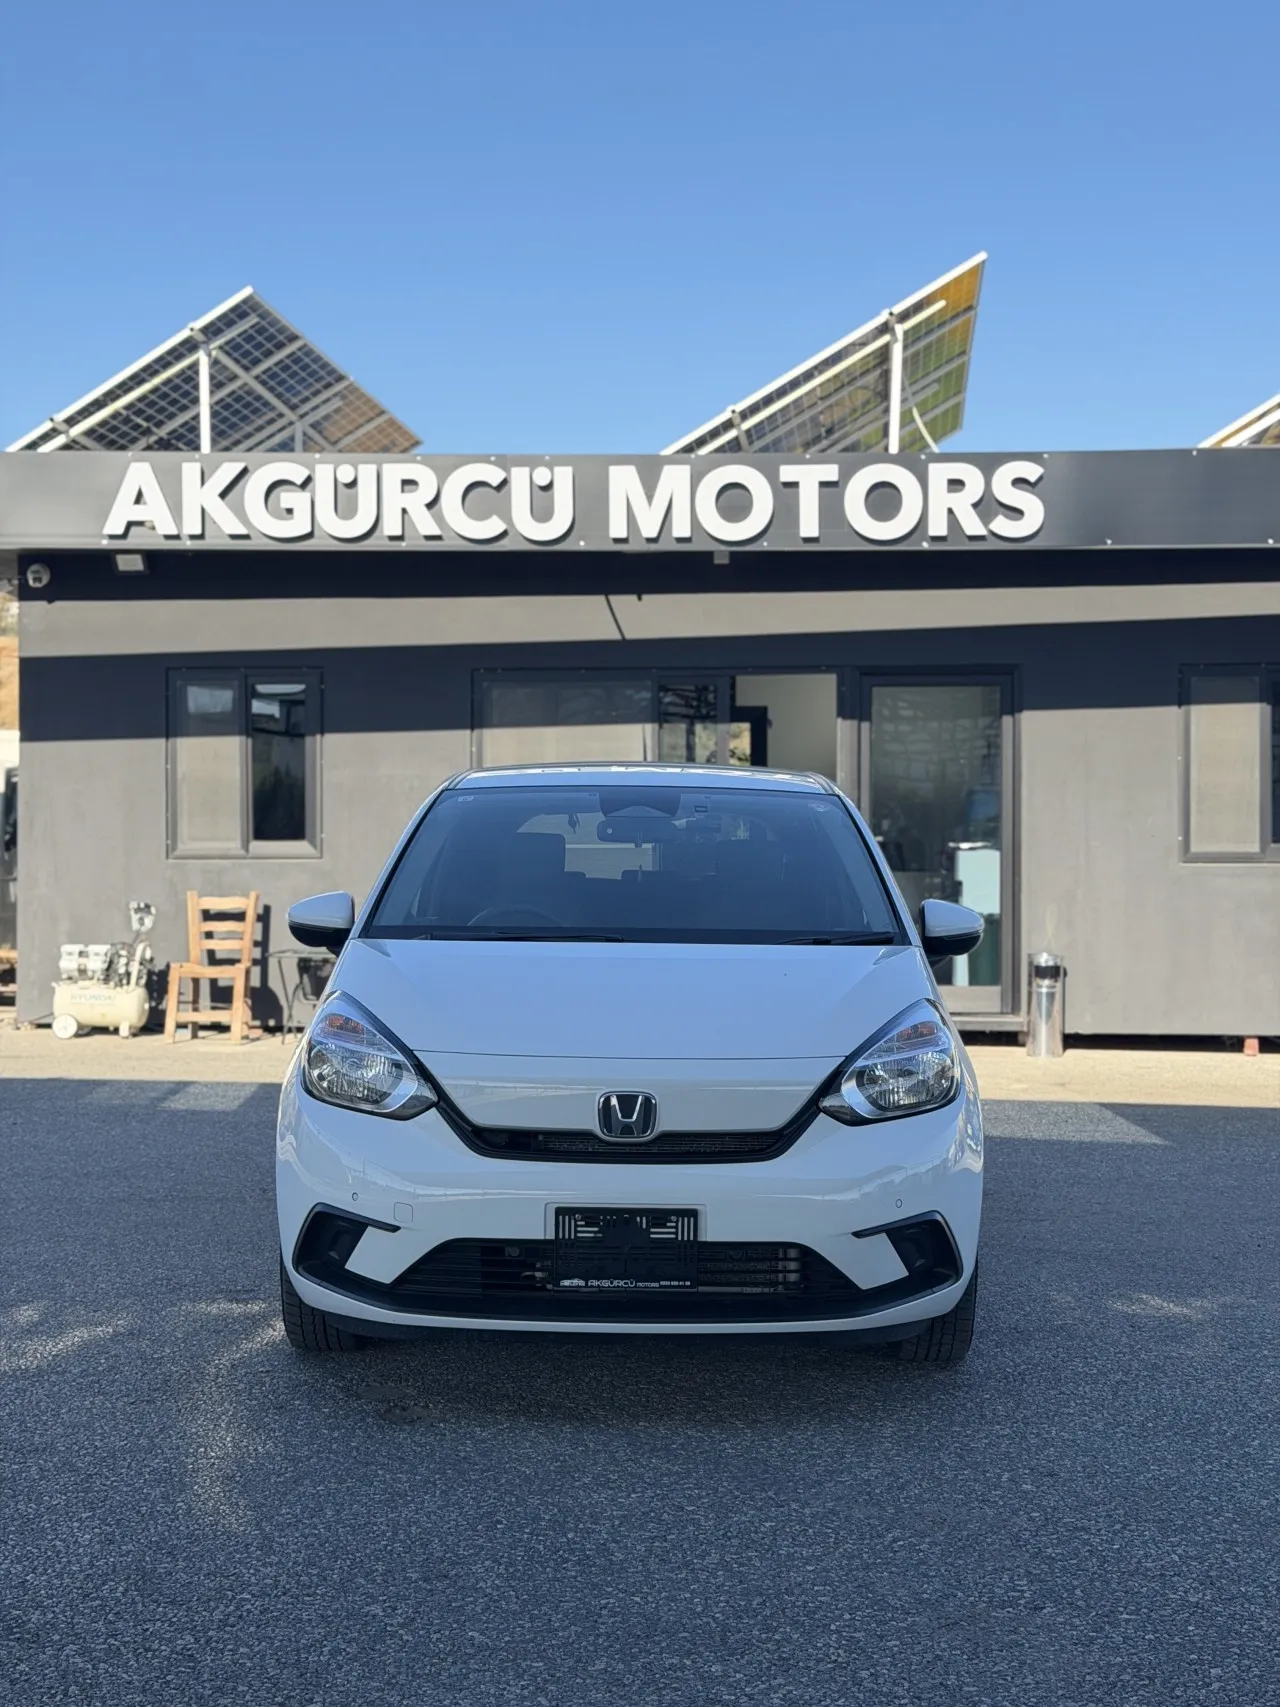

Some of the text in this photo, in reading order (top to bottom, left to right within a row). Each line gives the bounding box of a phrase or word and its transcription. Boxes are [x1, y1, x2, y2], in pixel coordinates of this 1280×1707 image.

[102, 460, 1045, 541] AKGÜRCÜ MOTORS
[588, 1279, 635, 1287] AKGÜRCÜ
